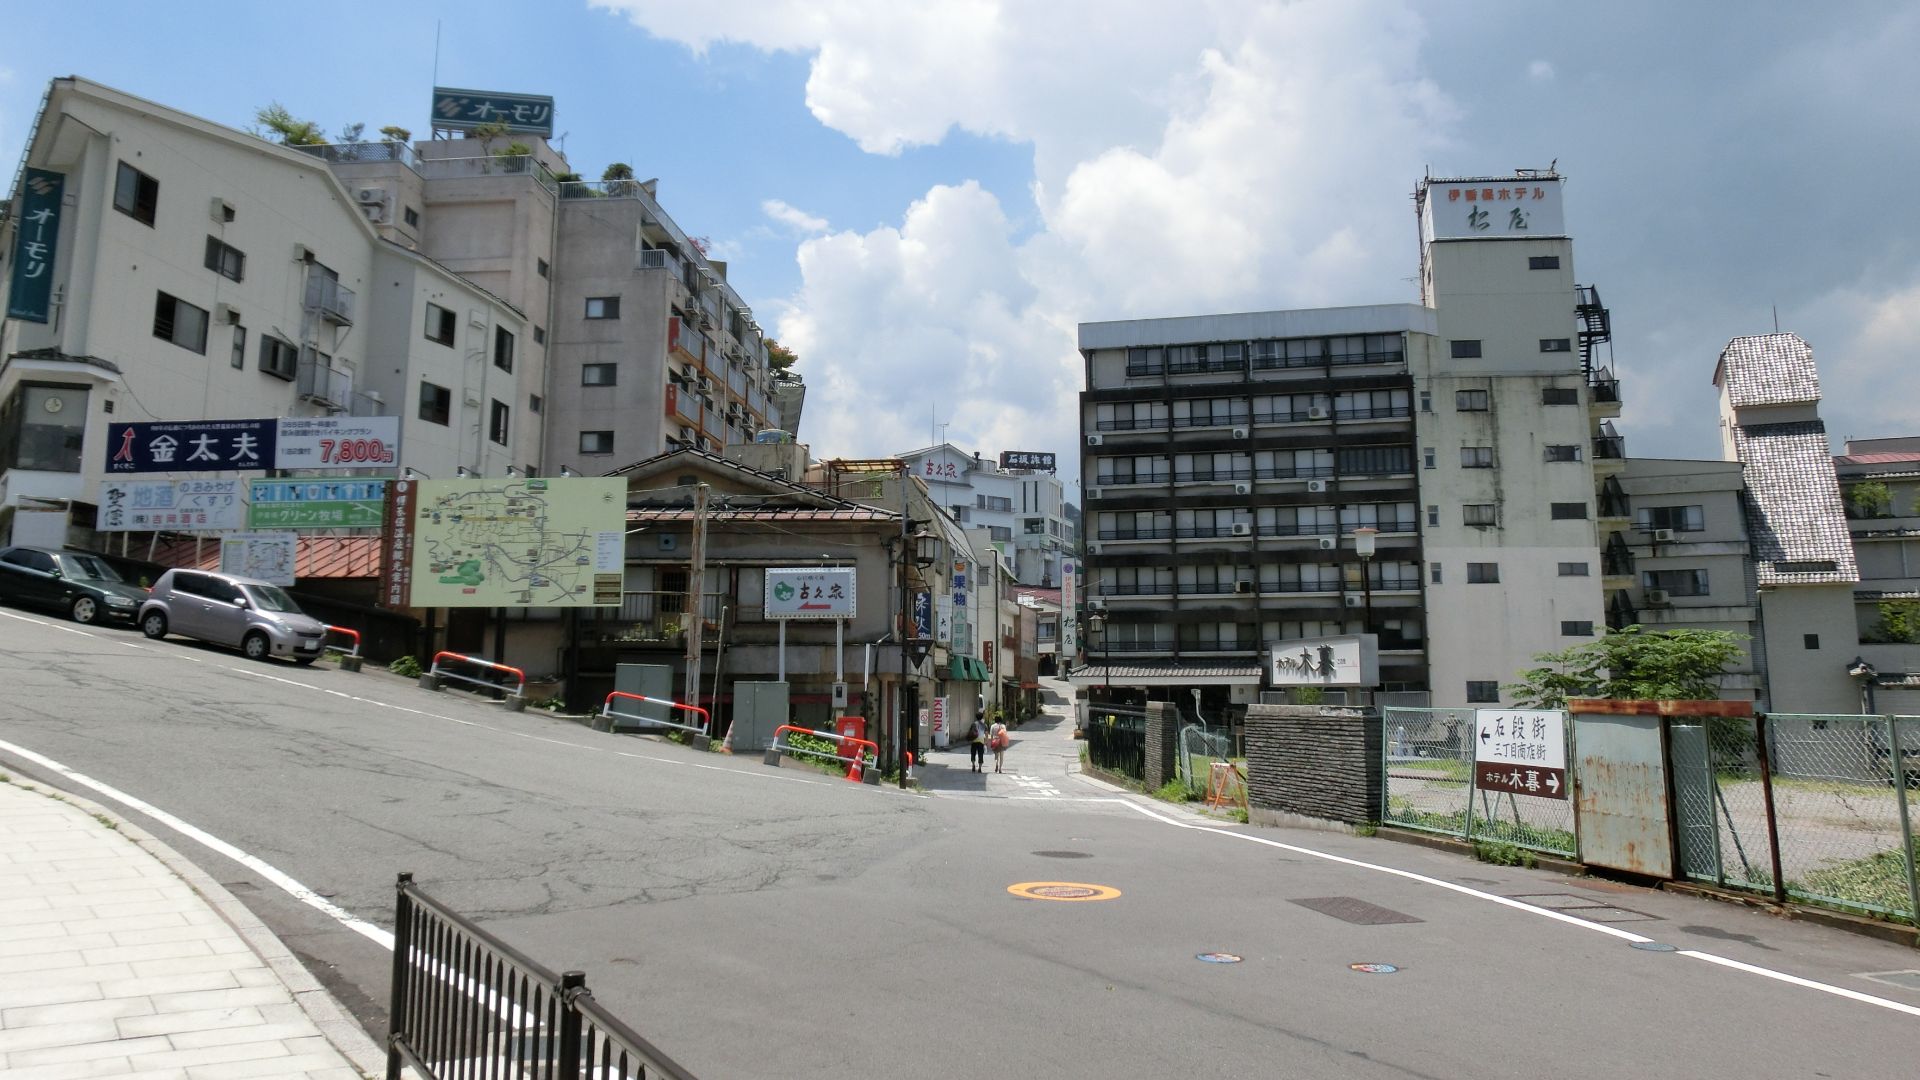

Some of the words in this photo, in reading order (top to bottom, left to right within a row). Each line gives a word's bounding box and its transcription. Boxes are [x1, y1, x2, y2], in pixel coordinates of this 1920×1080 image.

[468, 101, 549, 123] オーモリ
[1468, 205, 1530, 231] 松屋
[24, 208, 55, 279] オーモリ
[149, 432, 260, 462] 金太夫
[319, 439, 393, 464] 7,800円
[926, 459, 958, 479] 古久家
[132, 485, 174, 508] 地酒
[800, 581, 844, 600] 古久家
[954, 575, 966, 606] 果物
[934, 699, 943, 732] KIRIN
[1495, 715, 1546, 740] 石段街
[1494, 742, 1546, 761] 三丁目商店街
[1486, 768, 1541, 792] ホテル木暮
